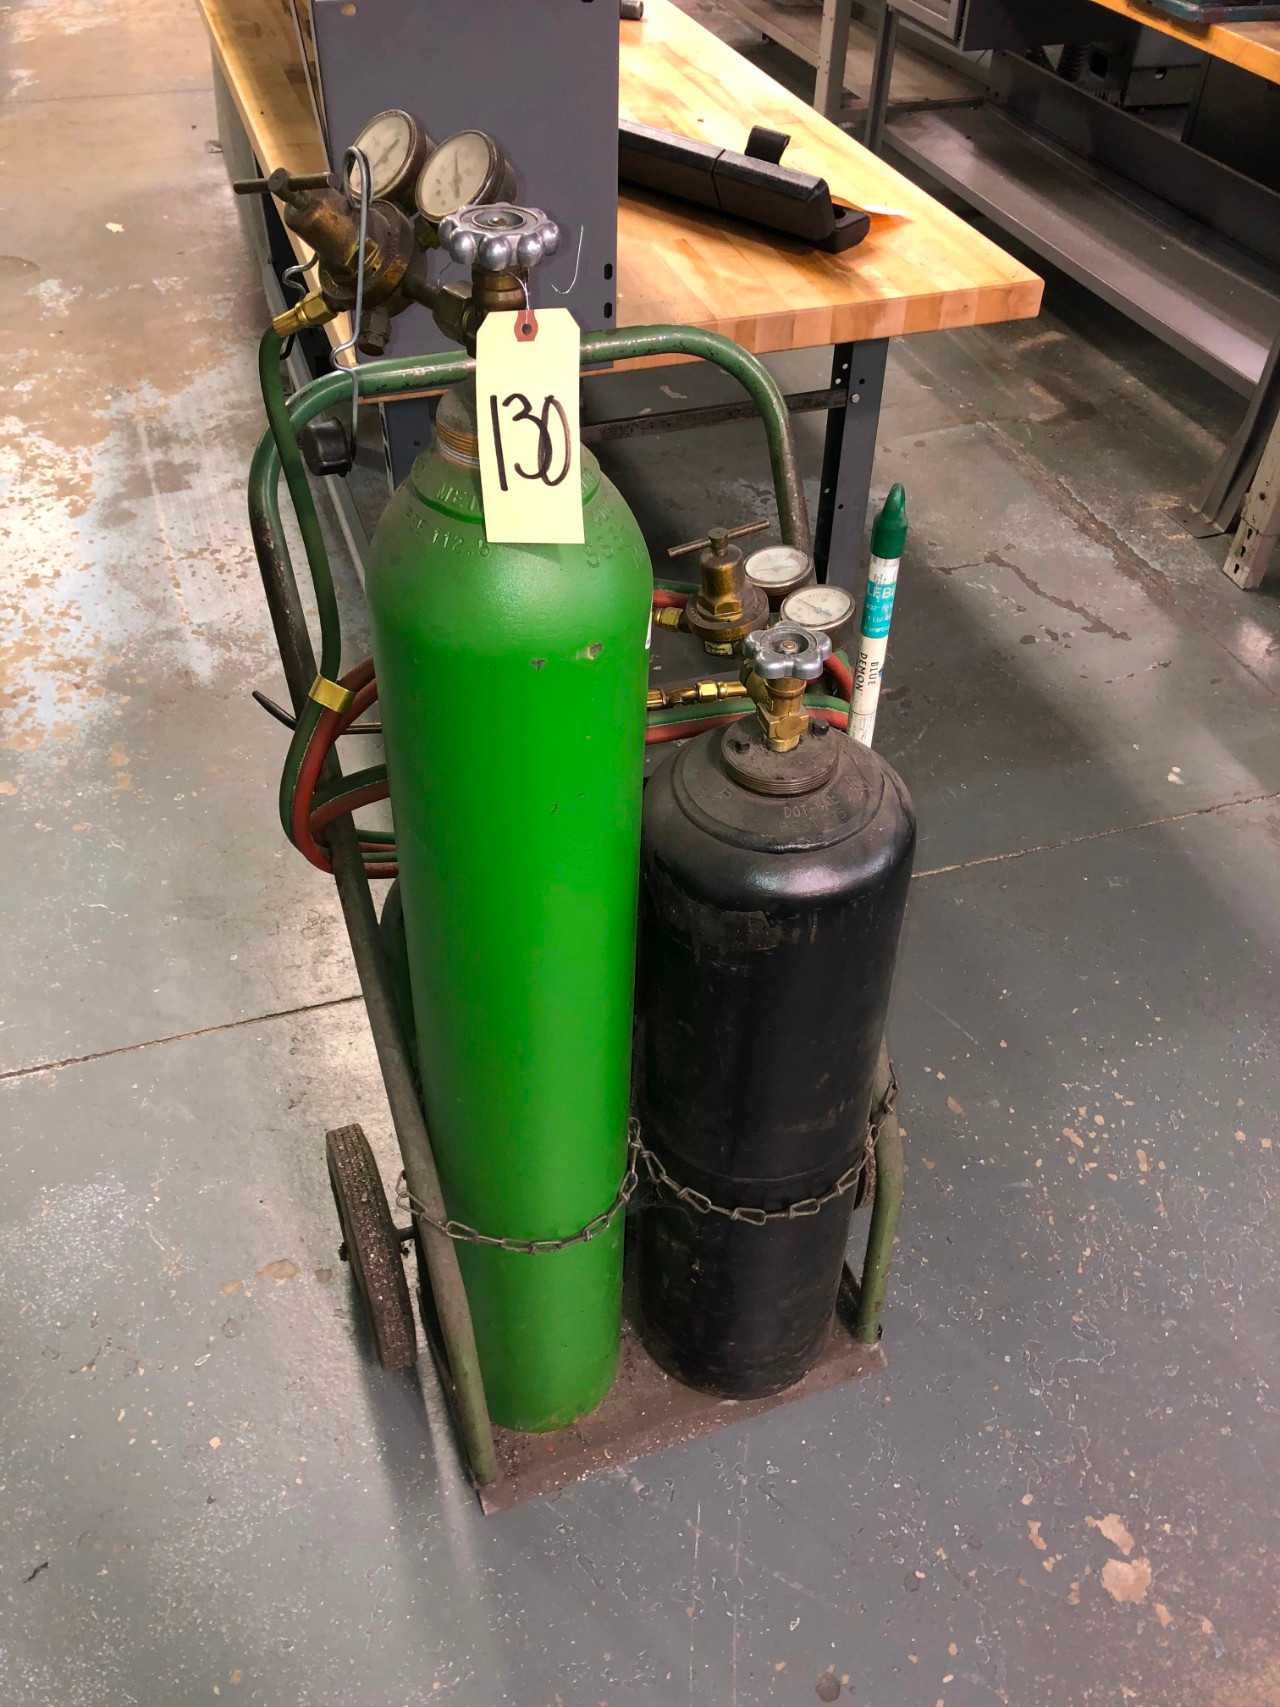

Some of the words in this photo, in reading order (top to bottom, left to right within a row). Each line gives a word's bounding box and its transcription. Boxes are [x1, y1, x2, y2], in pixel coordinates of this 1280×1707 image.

[489, 393, 572, 492] 130
[855, 651, 868, 692] DEMON
[867, 661, 880, 687] BLUE
